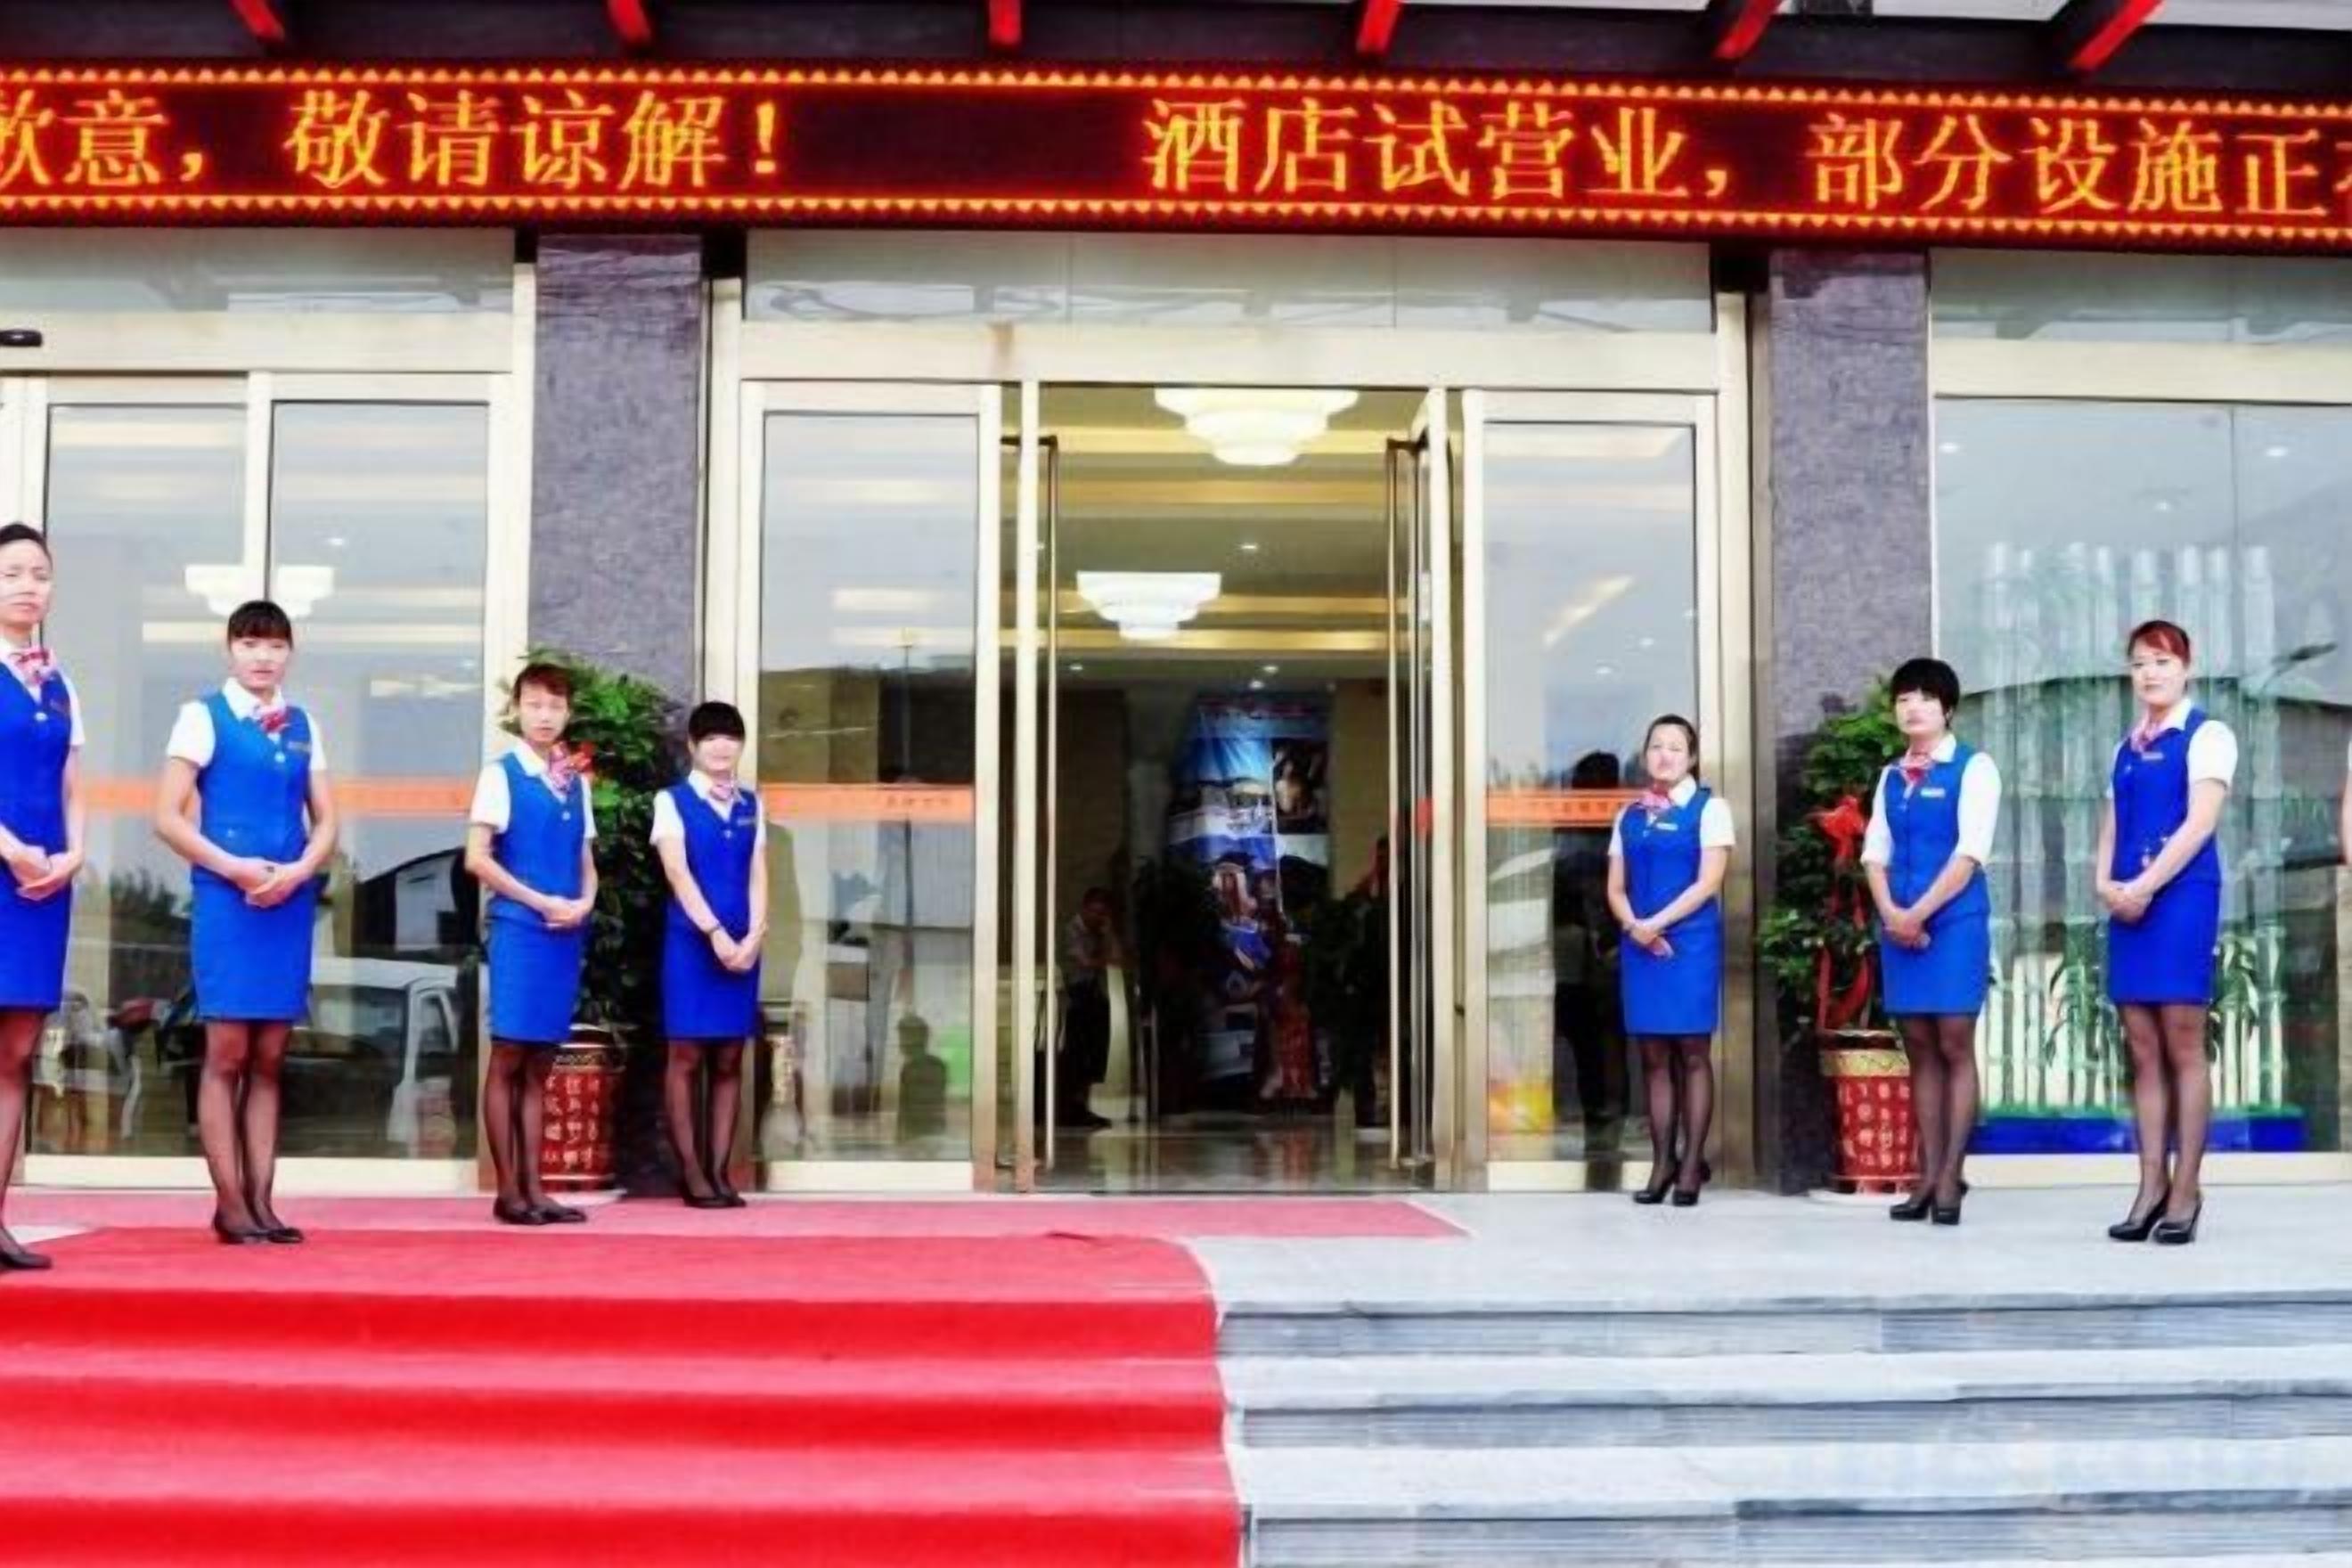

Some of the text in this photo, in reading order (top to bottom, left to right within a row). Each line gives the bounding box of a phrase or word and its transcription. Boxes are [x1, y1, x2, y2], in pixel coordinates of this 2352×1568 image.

[1143, 96, 2352, 216] 酒店试营业，部分设施正
